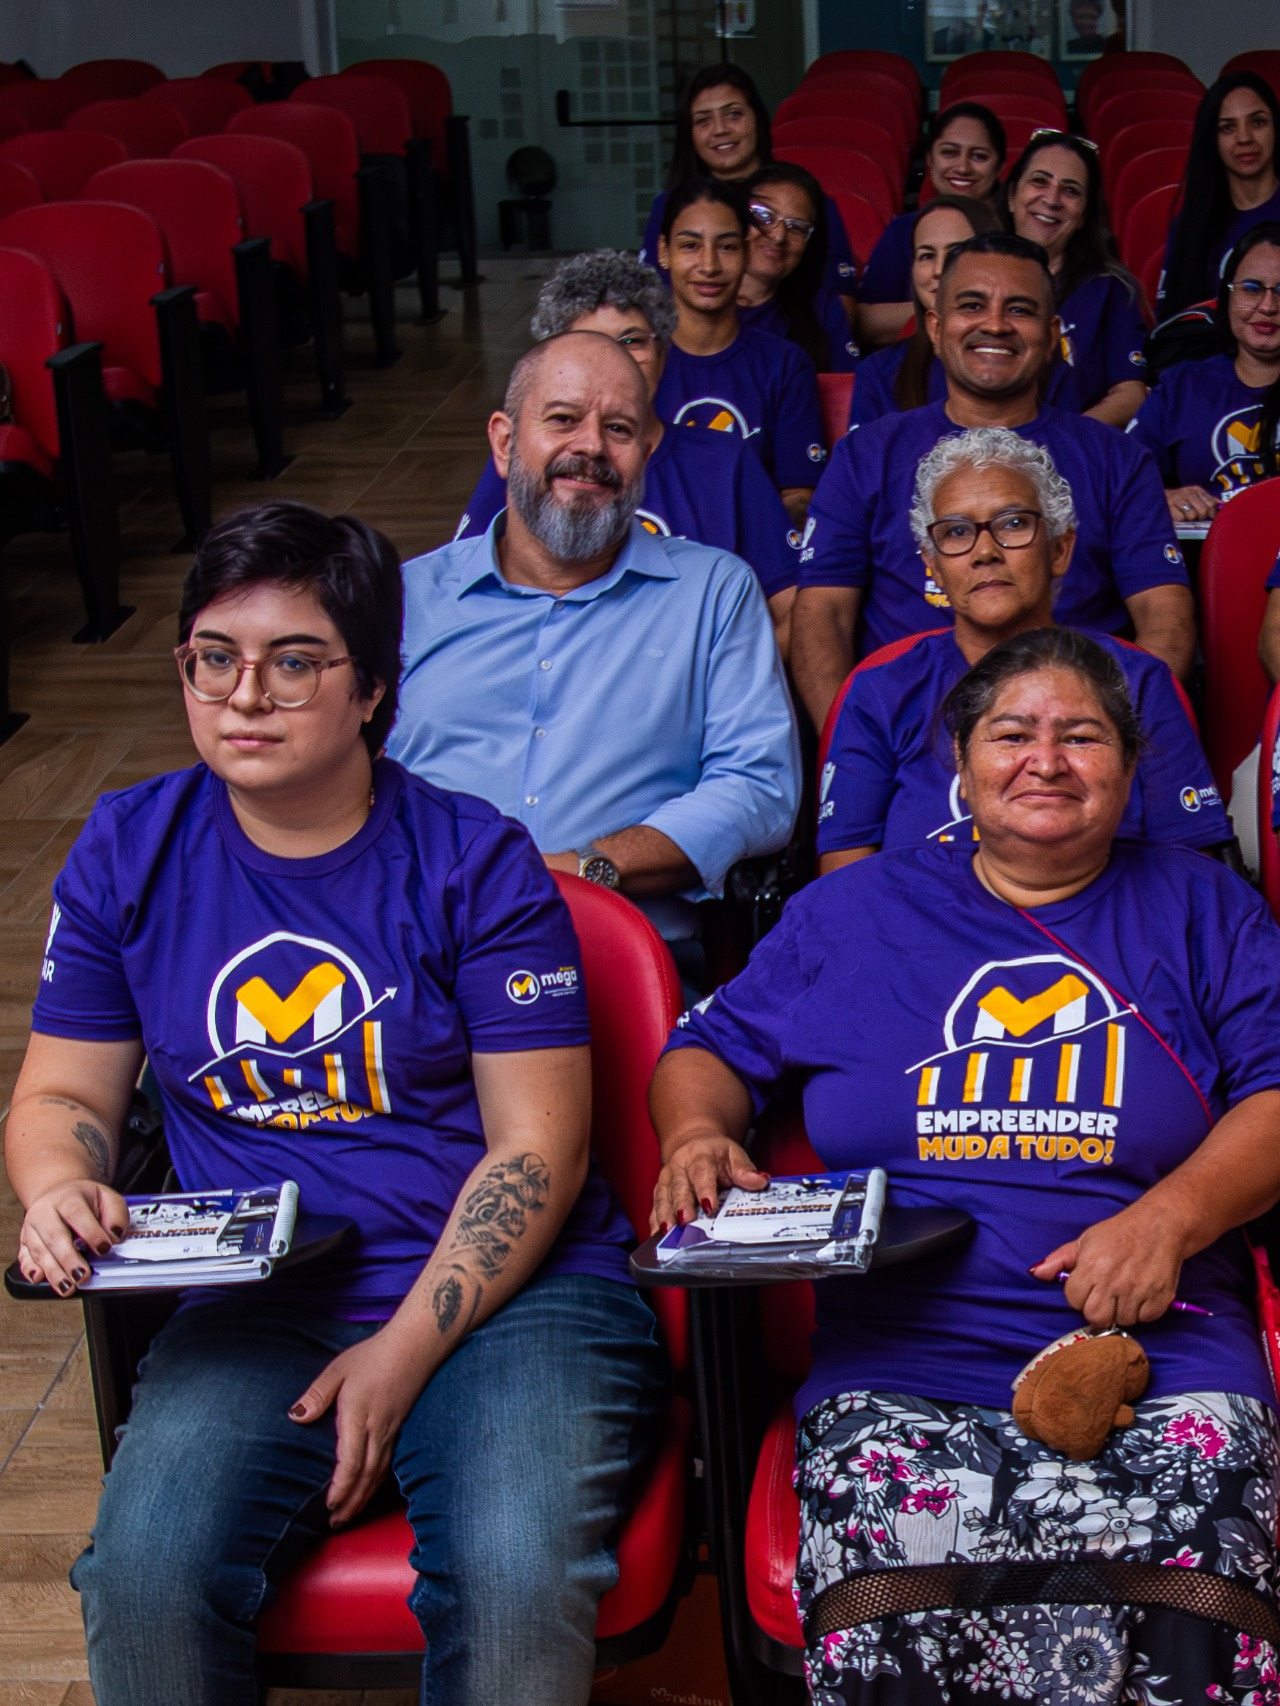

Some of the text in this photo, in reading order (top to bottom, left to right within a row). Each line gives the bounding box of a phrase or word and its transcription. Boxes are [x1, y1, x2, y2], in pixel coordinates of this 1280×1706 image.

[541, 969, 578, 987] mega
[917, 1109, 1118, 1137] EMPREENDER
[917, 1135, 1115, 1166] MUDA TUDO!
